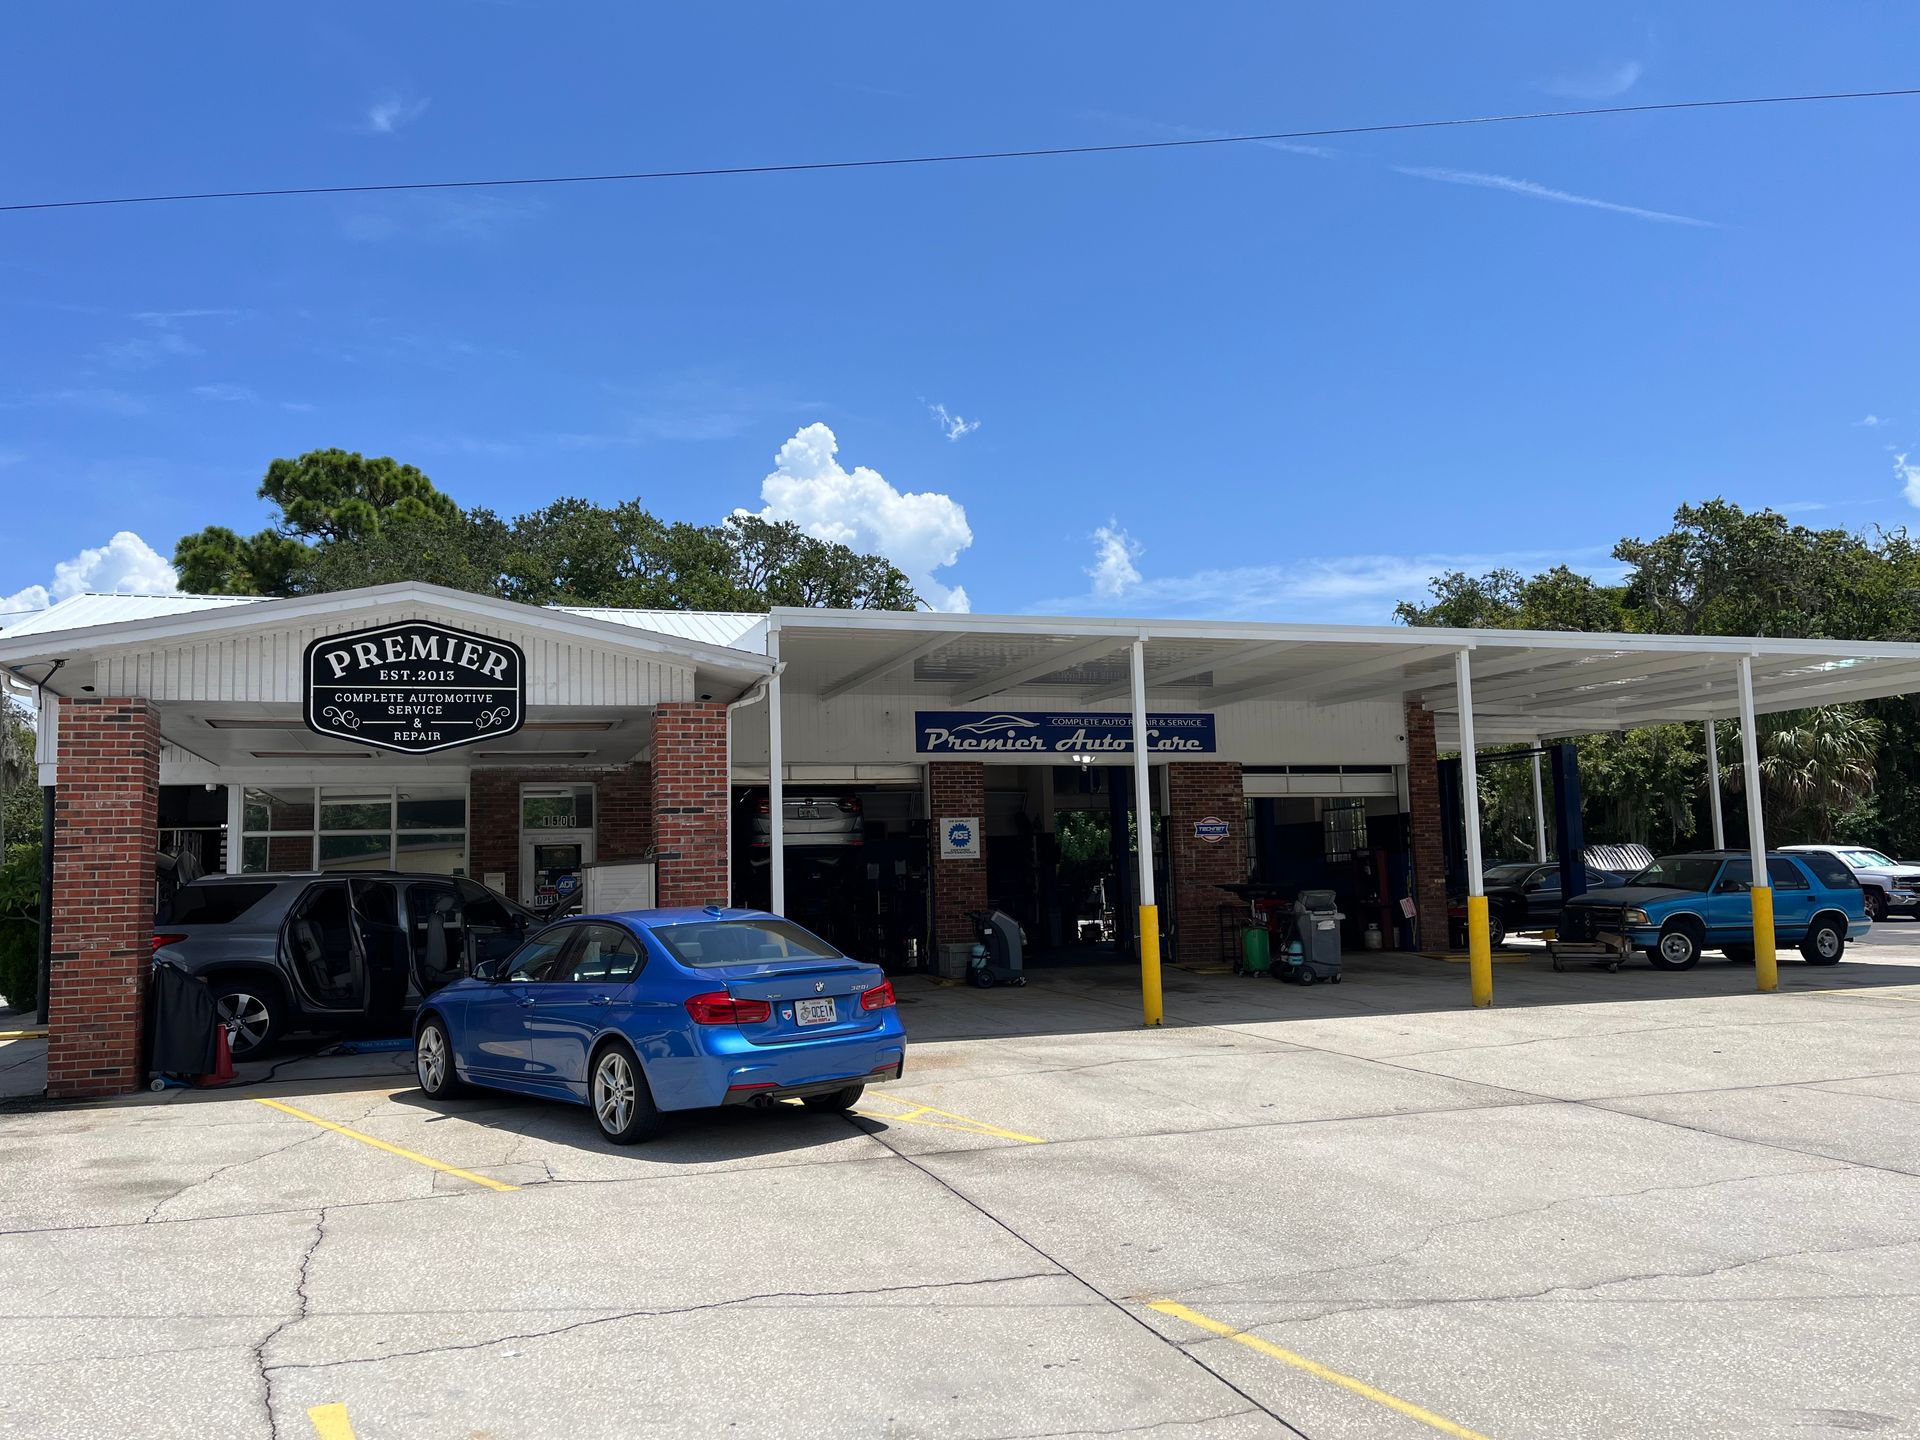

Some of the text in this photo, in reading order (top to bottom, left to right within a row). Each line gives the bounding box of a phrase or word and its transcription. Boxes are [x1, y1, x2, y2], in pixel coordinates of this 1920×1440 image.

[325, 635, 508, 681] PREMIER
[379, 670, 455, 681] EST.2013
[335, 693, 493, 703] COMPLETE AUTOMOTIVE
[388, 705, 443, 715] SERVICE
[413, 718, 422, 728] &
[1052, 718, 1100, 726] COMPLETE
[1168, 719, 1202, 727] SERVICE
[394, 732, 441, 741] REPAIR
[925, 728, 1047, 750] Premier
[1055, 729, 1134, 751] Auto
[544, 816, 576, 826] 1501
[951, 831, 968, 839] ASE
[559, 880, 576, 889] ADT
[537, 894, 558, 905] OPEN
